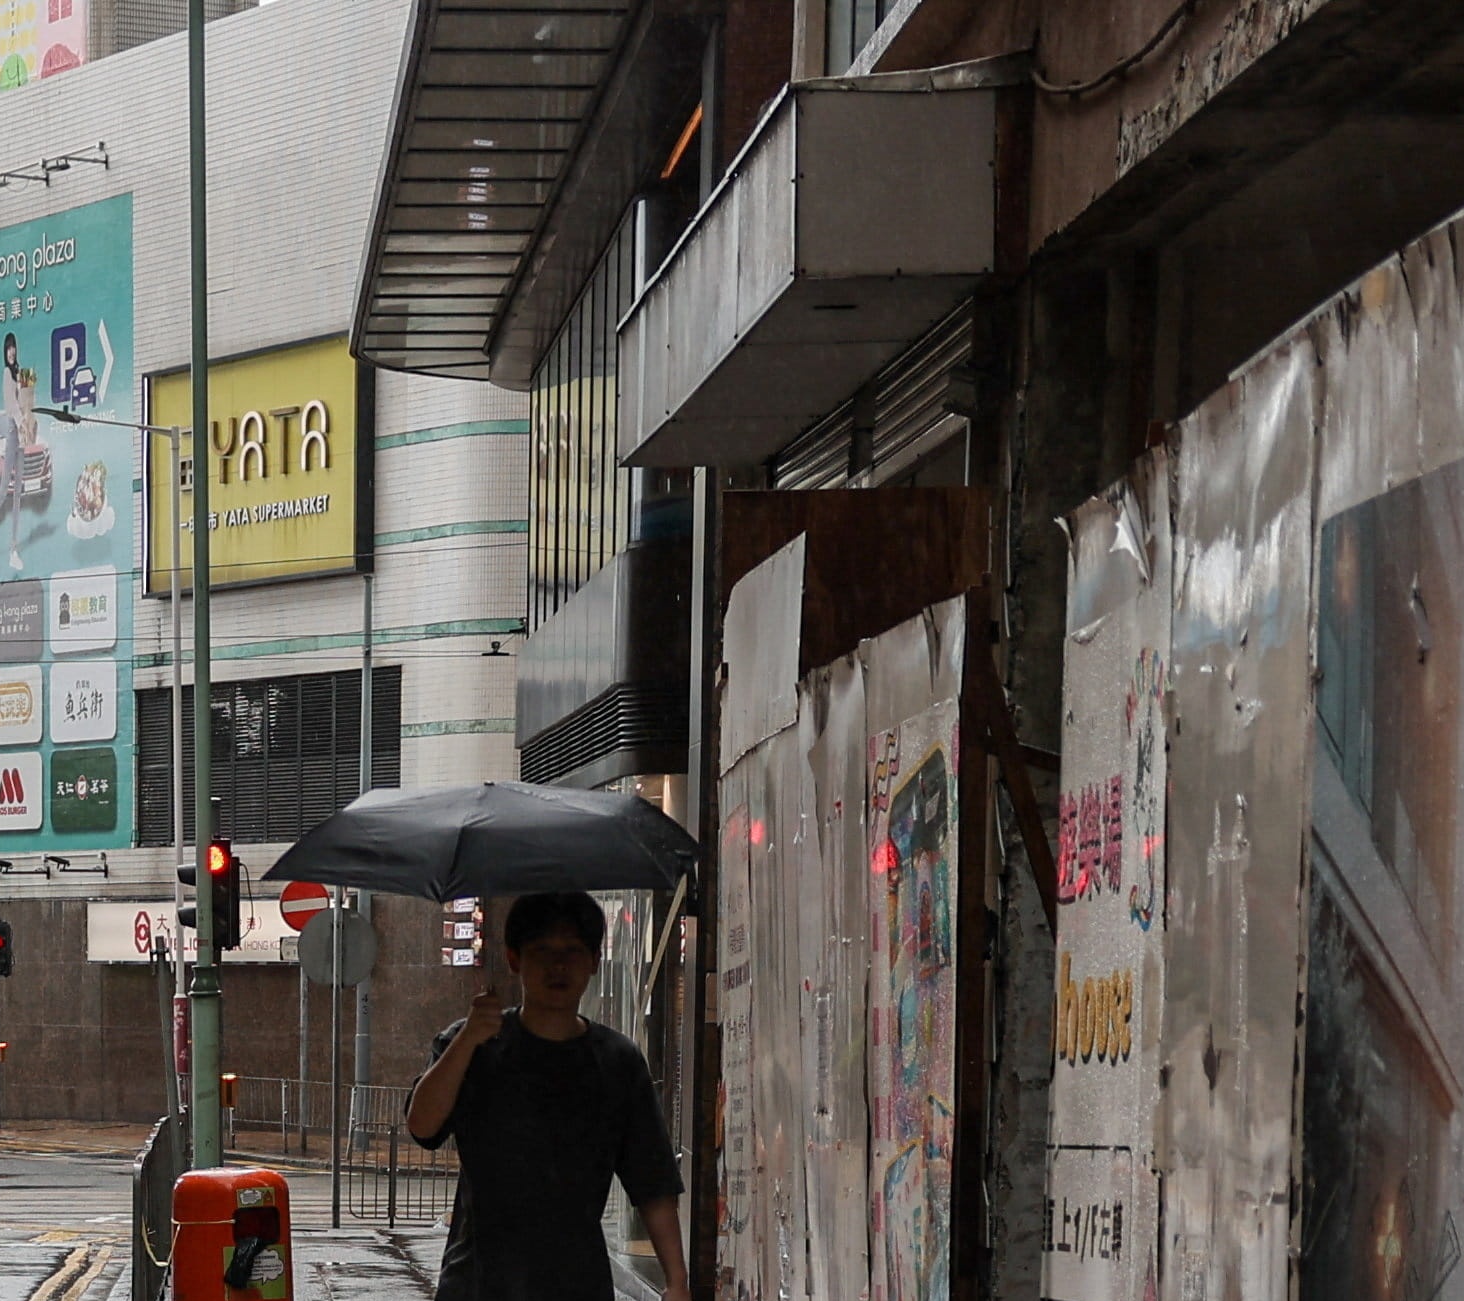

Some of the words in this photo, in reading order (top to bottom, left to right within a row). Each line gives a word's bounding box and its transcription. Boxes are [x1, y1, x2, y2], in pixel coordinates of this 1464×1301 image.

[32, 232, 76, 289] plaza
[59, 337, 78, 390] P
[210, 399, 331, 485] YATA
[222, 508, 250, 528] YATA
[252, 494, 330, 524] SUPERMARKET
[3, 602, 20, 622] kong
[20, 601, 38, 623] plaza
[1058, 951, 1133, 1070] house
